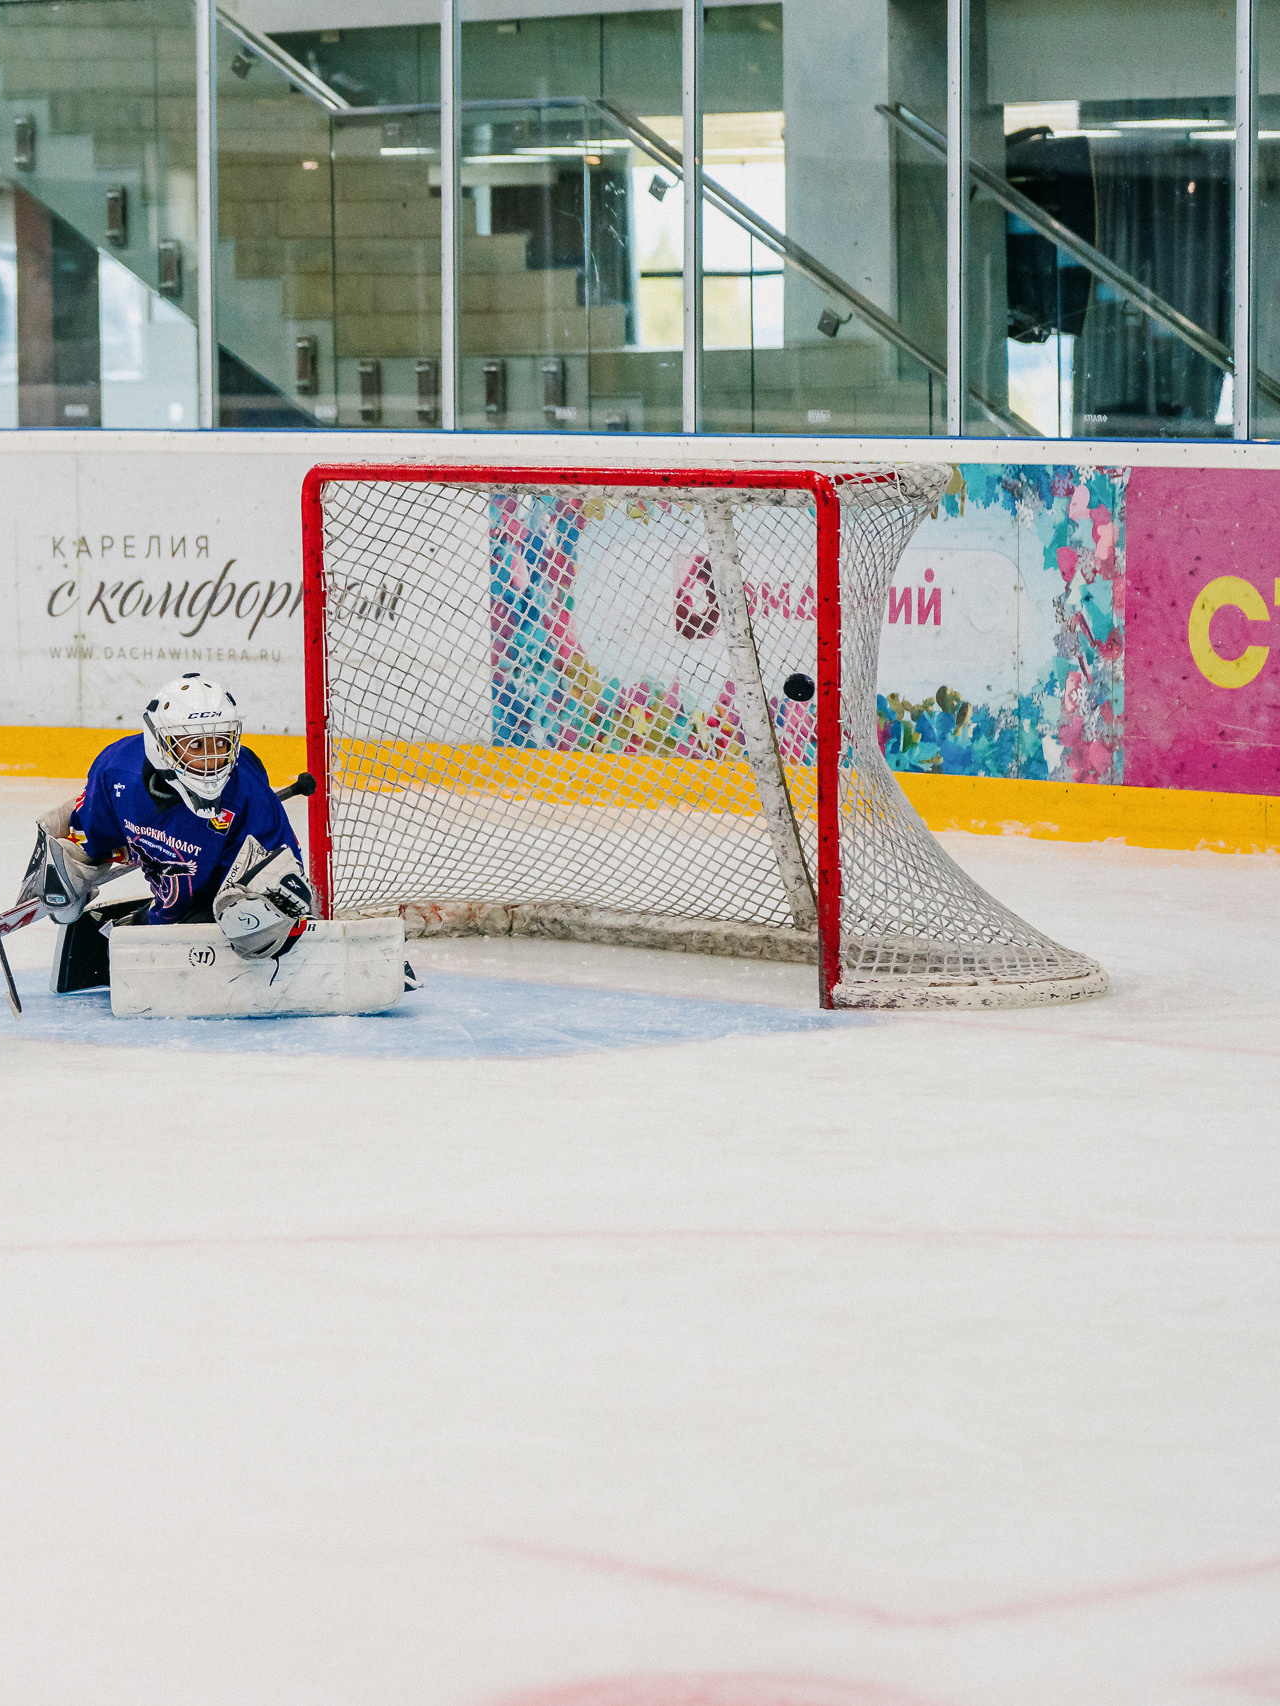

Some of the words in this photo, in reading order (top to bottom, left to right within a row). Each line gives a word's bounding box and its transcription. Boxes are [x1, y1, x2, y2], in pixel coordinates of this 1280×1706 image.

[52, 535, 210, 558] КАРЕЛИЯ
[1188, 575, 1280, 690] С
[48, 644, 283, 663] WWW.DACHAWINTERA.RU
[187, 711, 223, 720] CCM
[166, 835, 202, 857] МОЛОТ
